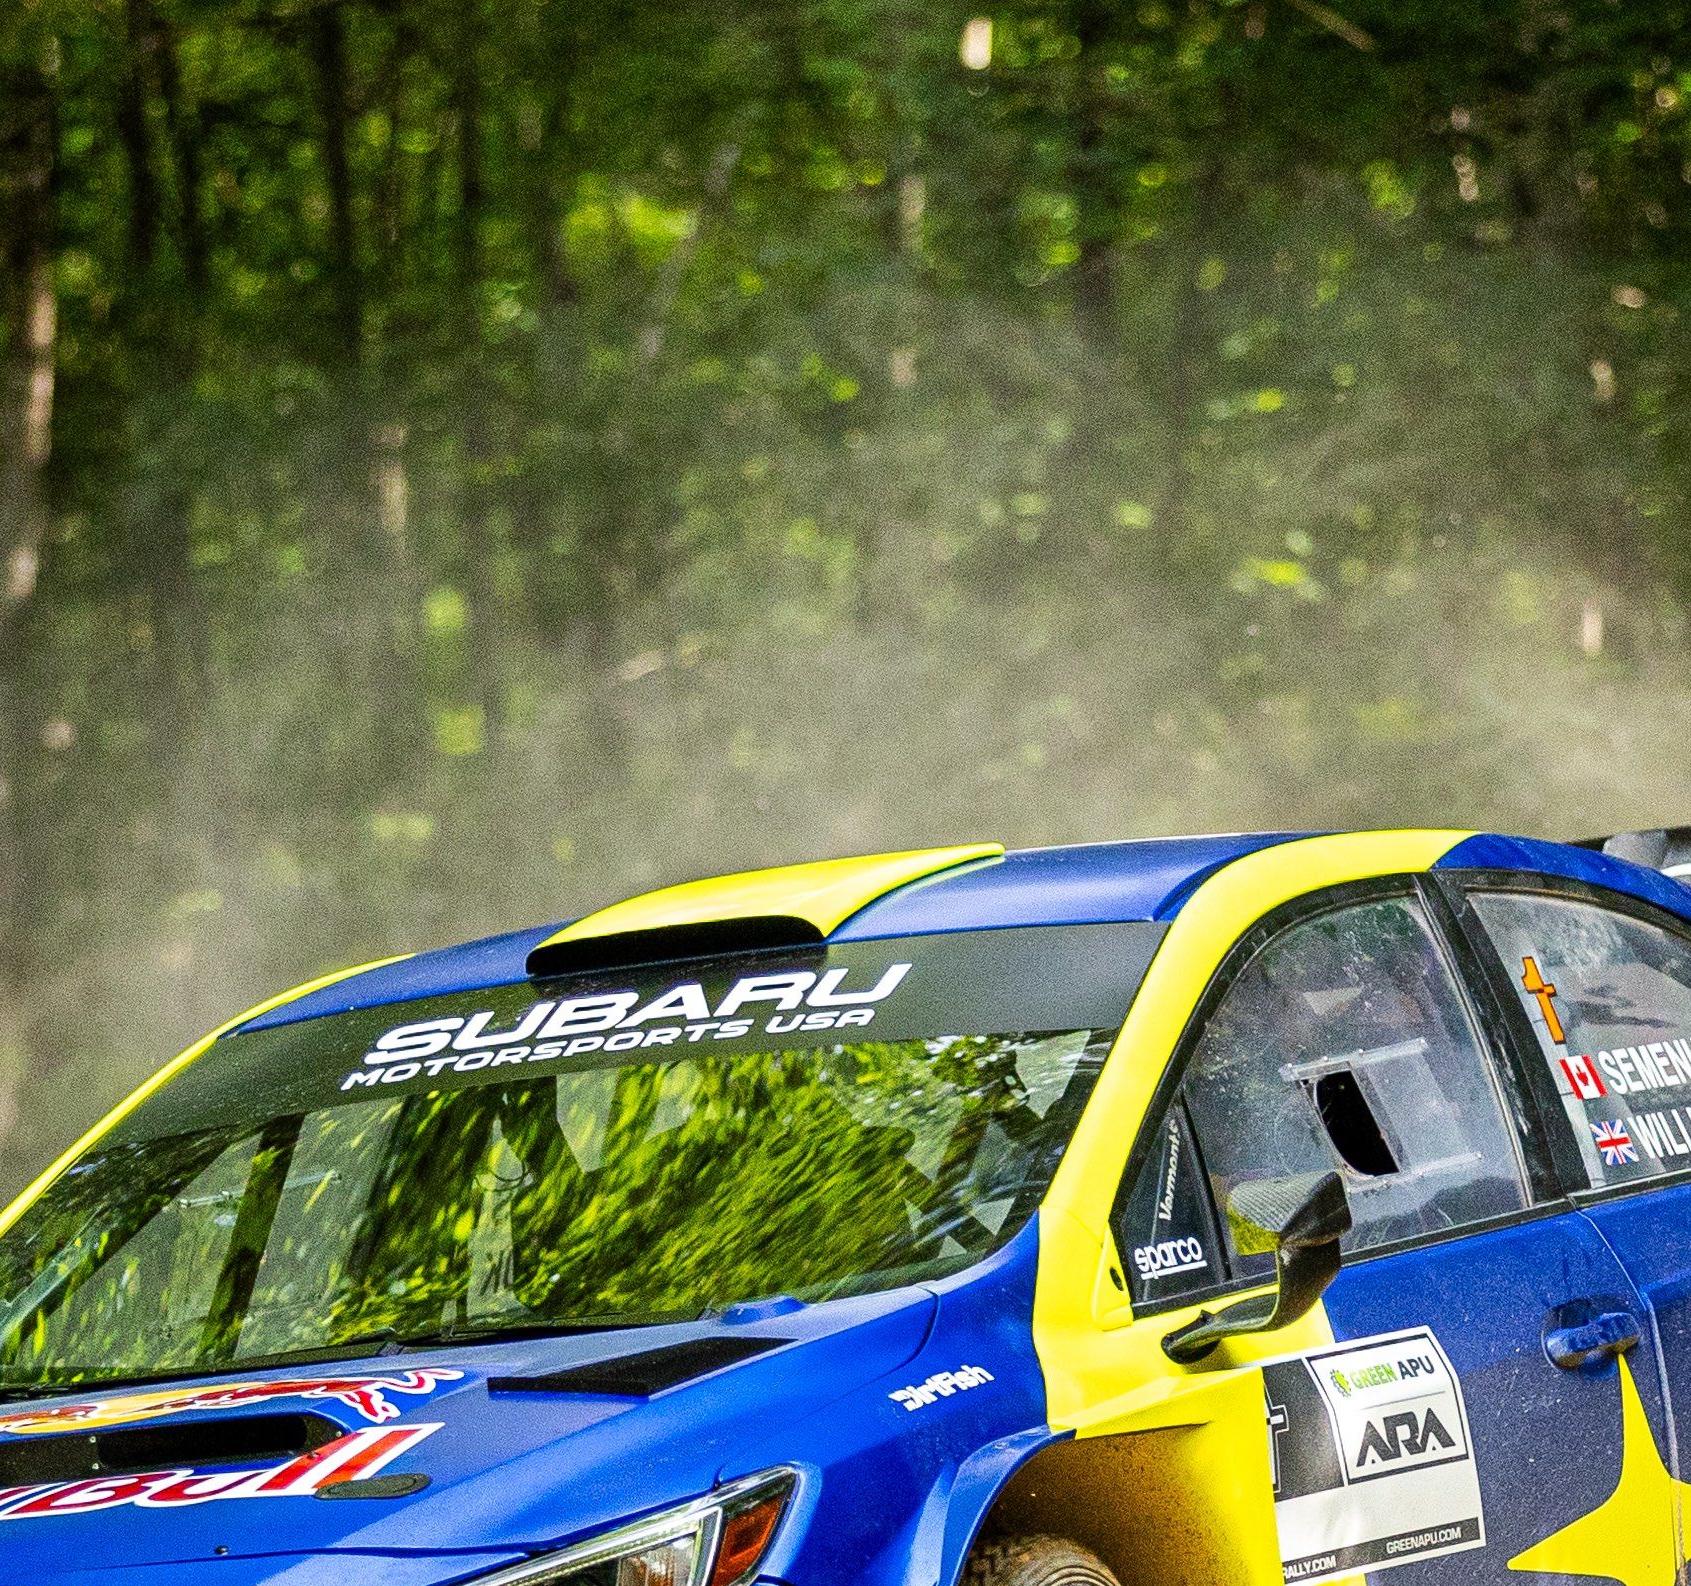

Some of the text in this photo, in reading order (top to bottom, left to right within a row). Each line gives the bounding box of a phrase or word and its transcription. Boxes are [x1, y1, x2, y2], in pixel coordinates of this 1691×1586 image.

[363, 963, 913, 1065] SUBARU
[340, 1009, 876, 1091] MOTORSPORTS USA
[1135, 1236, 1203, 1278] sparco
[1350, 1355, 1435, 1389] GREEN APU
[1356, 1407, 1456, 1467] ARA
[1386, 1527, 1461, 1553] GREENAPU.COM
